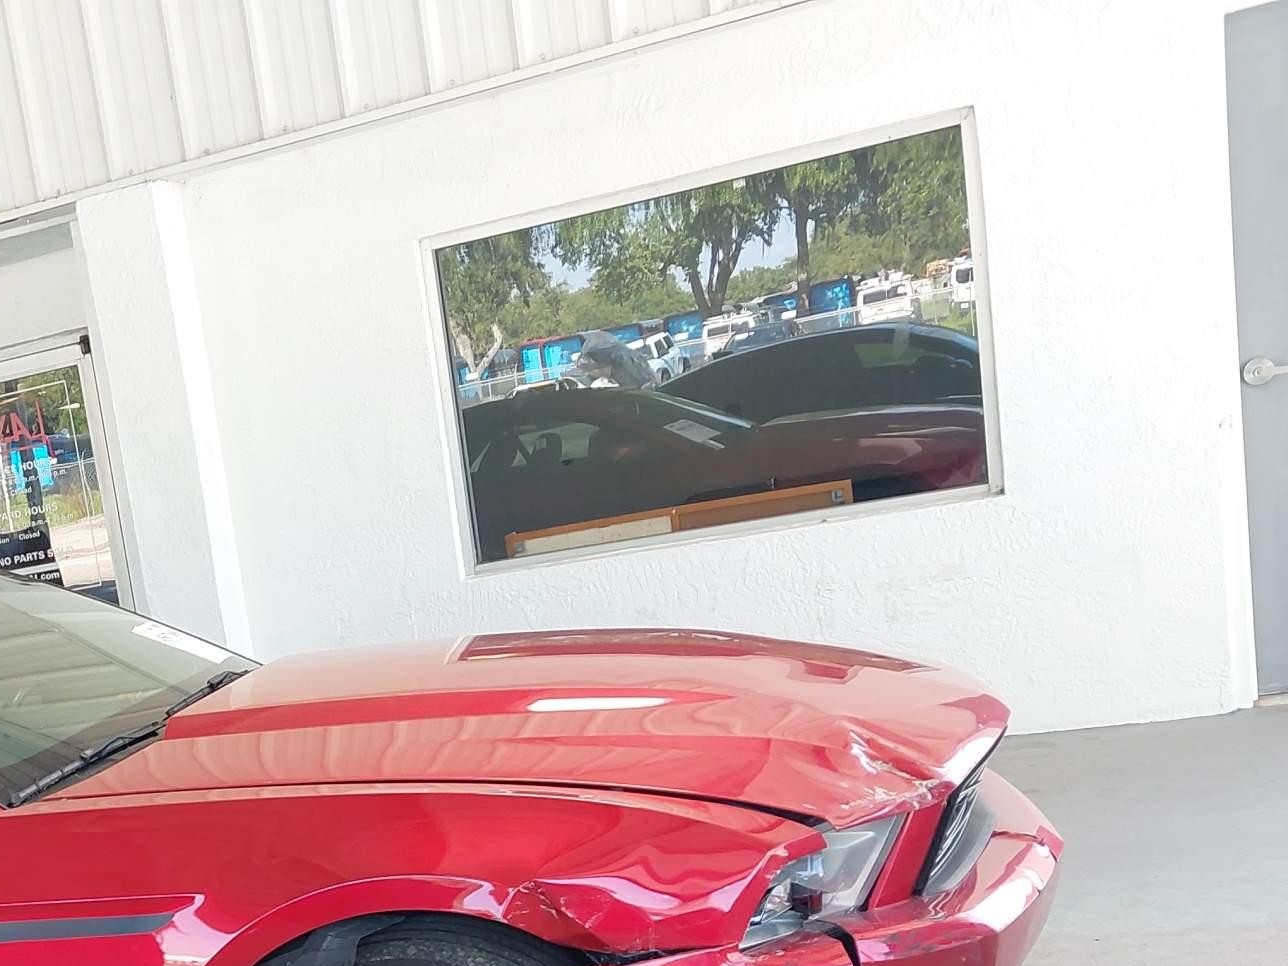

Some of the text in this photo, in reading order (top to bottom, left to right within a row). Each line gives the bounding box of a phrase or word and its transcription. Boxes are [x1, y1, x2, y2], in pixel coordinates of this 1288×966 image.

[25, 502, 59, 516] HOURS
[18, 530, 41, 540] Closed
[14, 550, 46, 564] PARTS
